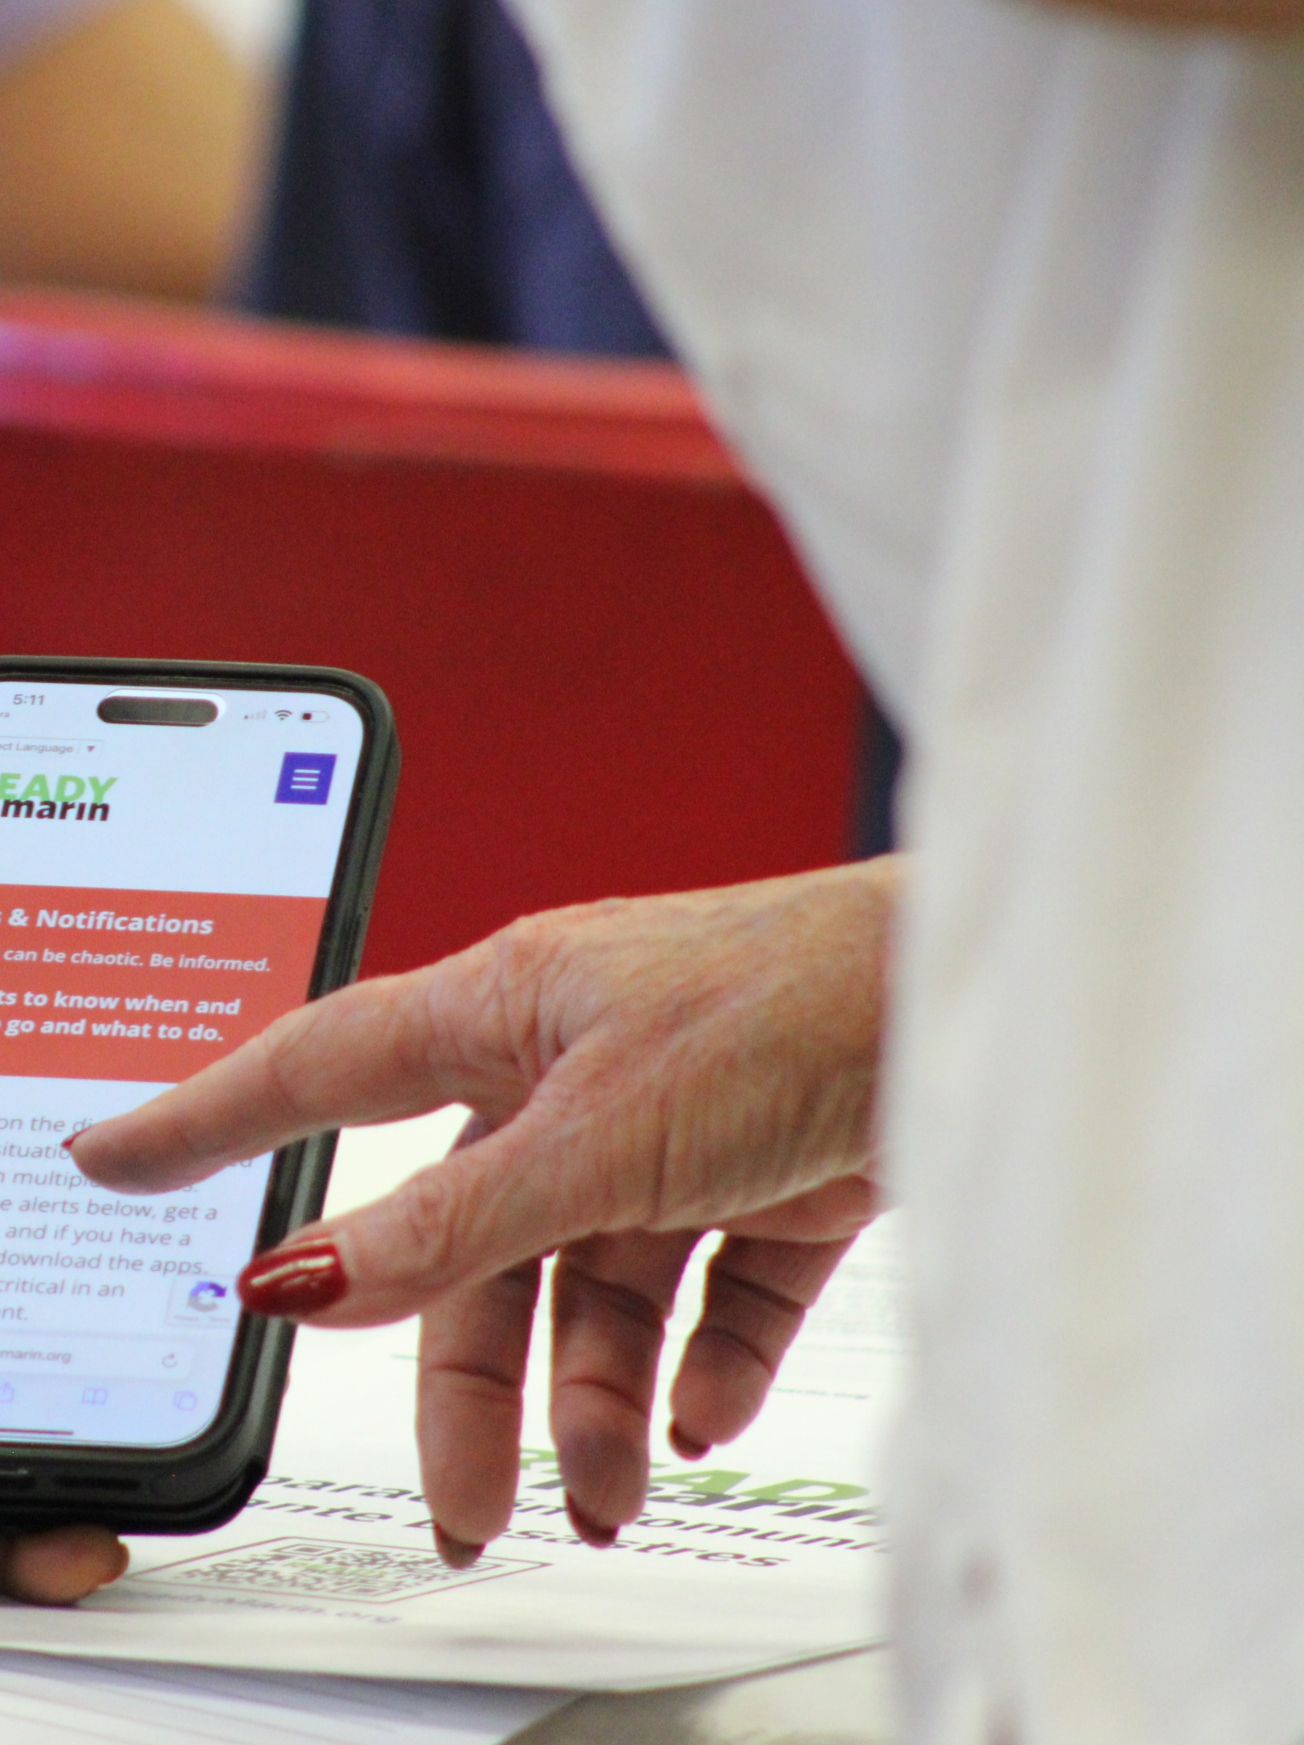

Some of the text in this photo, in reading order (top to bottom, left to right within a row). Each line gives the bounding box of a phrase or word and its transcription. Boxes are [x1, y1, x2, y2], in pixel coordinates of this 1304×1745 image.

[13, 693, 45, 706] 5:11
[16, 741, 74, 754] Language
[0, 798, 110, 821] marin
[8, 908, 29, 927] &
[36, 908, 213, 935] Notifications
[3, 949, 37, 962] can
[42, 947, 66, 963] be
[71, 949, 144, 967] chaotic.
[150, 953, 173, 967] Be
[178, 954, 271, 973] informed.
[23, 991, 48, 1007] to
[53, 990, 119, 1010] know
[125, 994, 188, 1013] when
[195, 998, 241, 1016] and
[5, 1019, 35, 1037] go
[40, 1018, 85, 1036] and
[91, 1019, 150, 1038] what
[158, 1023, 182, 1040] to
[188, 1023, 224, 1042] do.
[30, 1114, 65, 1133] the
[18, 1196, 79, 1215] alerts
[86, 1199, 157, 1220] below,
[162, 1203, 199, 1222] get
[204, 1207, 218, 1220] a
[5, 1222, 46, 1240] and
[53, 1223, 70, 1242] if
[71, 1228, 113, 1246] you
[120, 1227, 171, 1246] have
[178, 1233, 191, 1246] a
[108, 1254, 144, 1272] the
[150, 1259, 208, 1276] apps.
[71, 1279, 92, 1296] in
[98, 1283, 125, 1298] an
